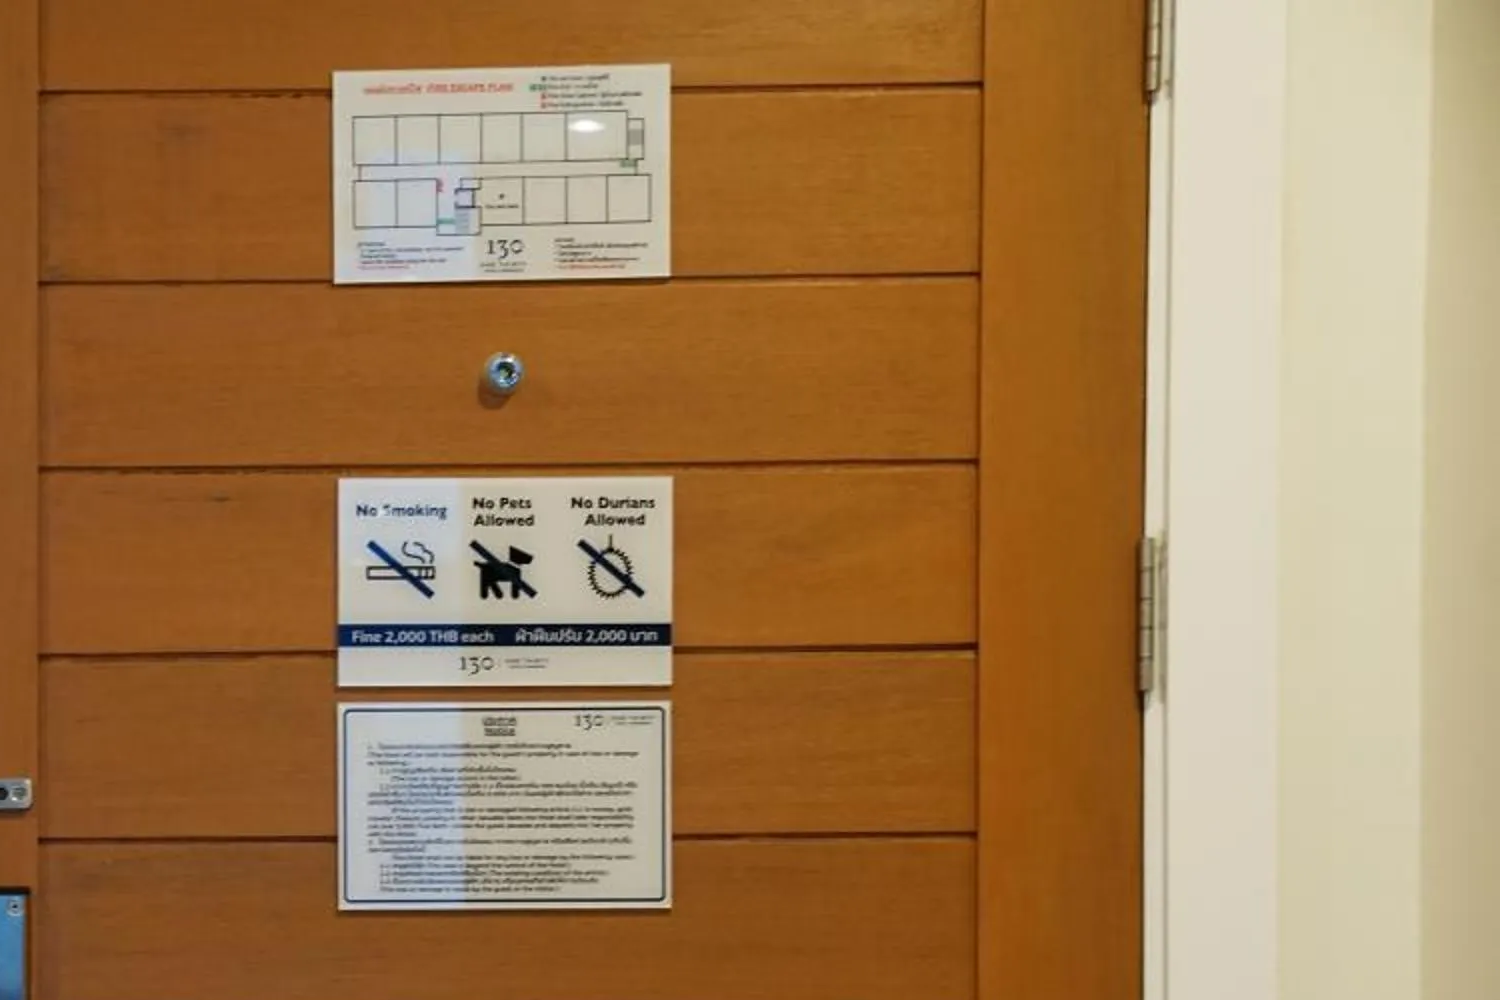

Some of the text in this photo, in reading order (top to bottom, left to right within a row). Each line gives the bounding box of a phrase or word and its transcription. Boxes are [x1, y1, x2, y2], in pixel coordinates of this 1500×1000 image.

[486, 239, 526, 258] 130
[472, 497, 533, 509] No Pets
[570, 496, 655, 508] No Durians
[355, 504, 377, 517] No
[473, 515, 535, 527] Allowed
[584, 513, 645, 526] Allowed
[351, 629, 495, 644] Fine 2,000 THB each
[585, 629, 627, 643] 2,000
[459, 655, 495, 676] 130
[574, 714, 605, 730] 130
